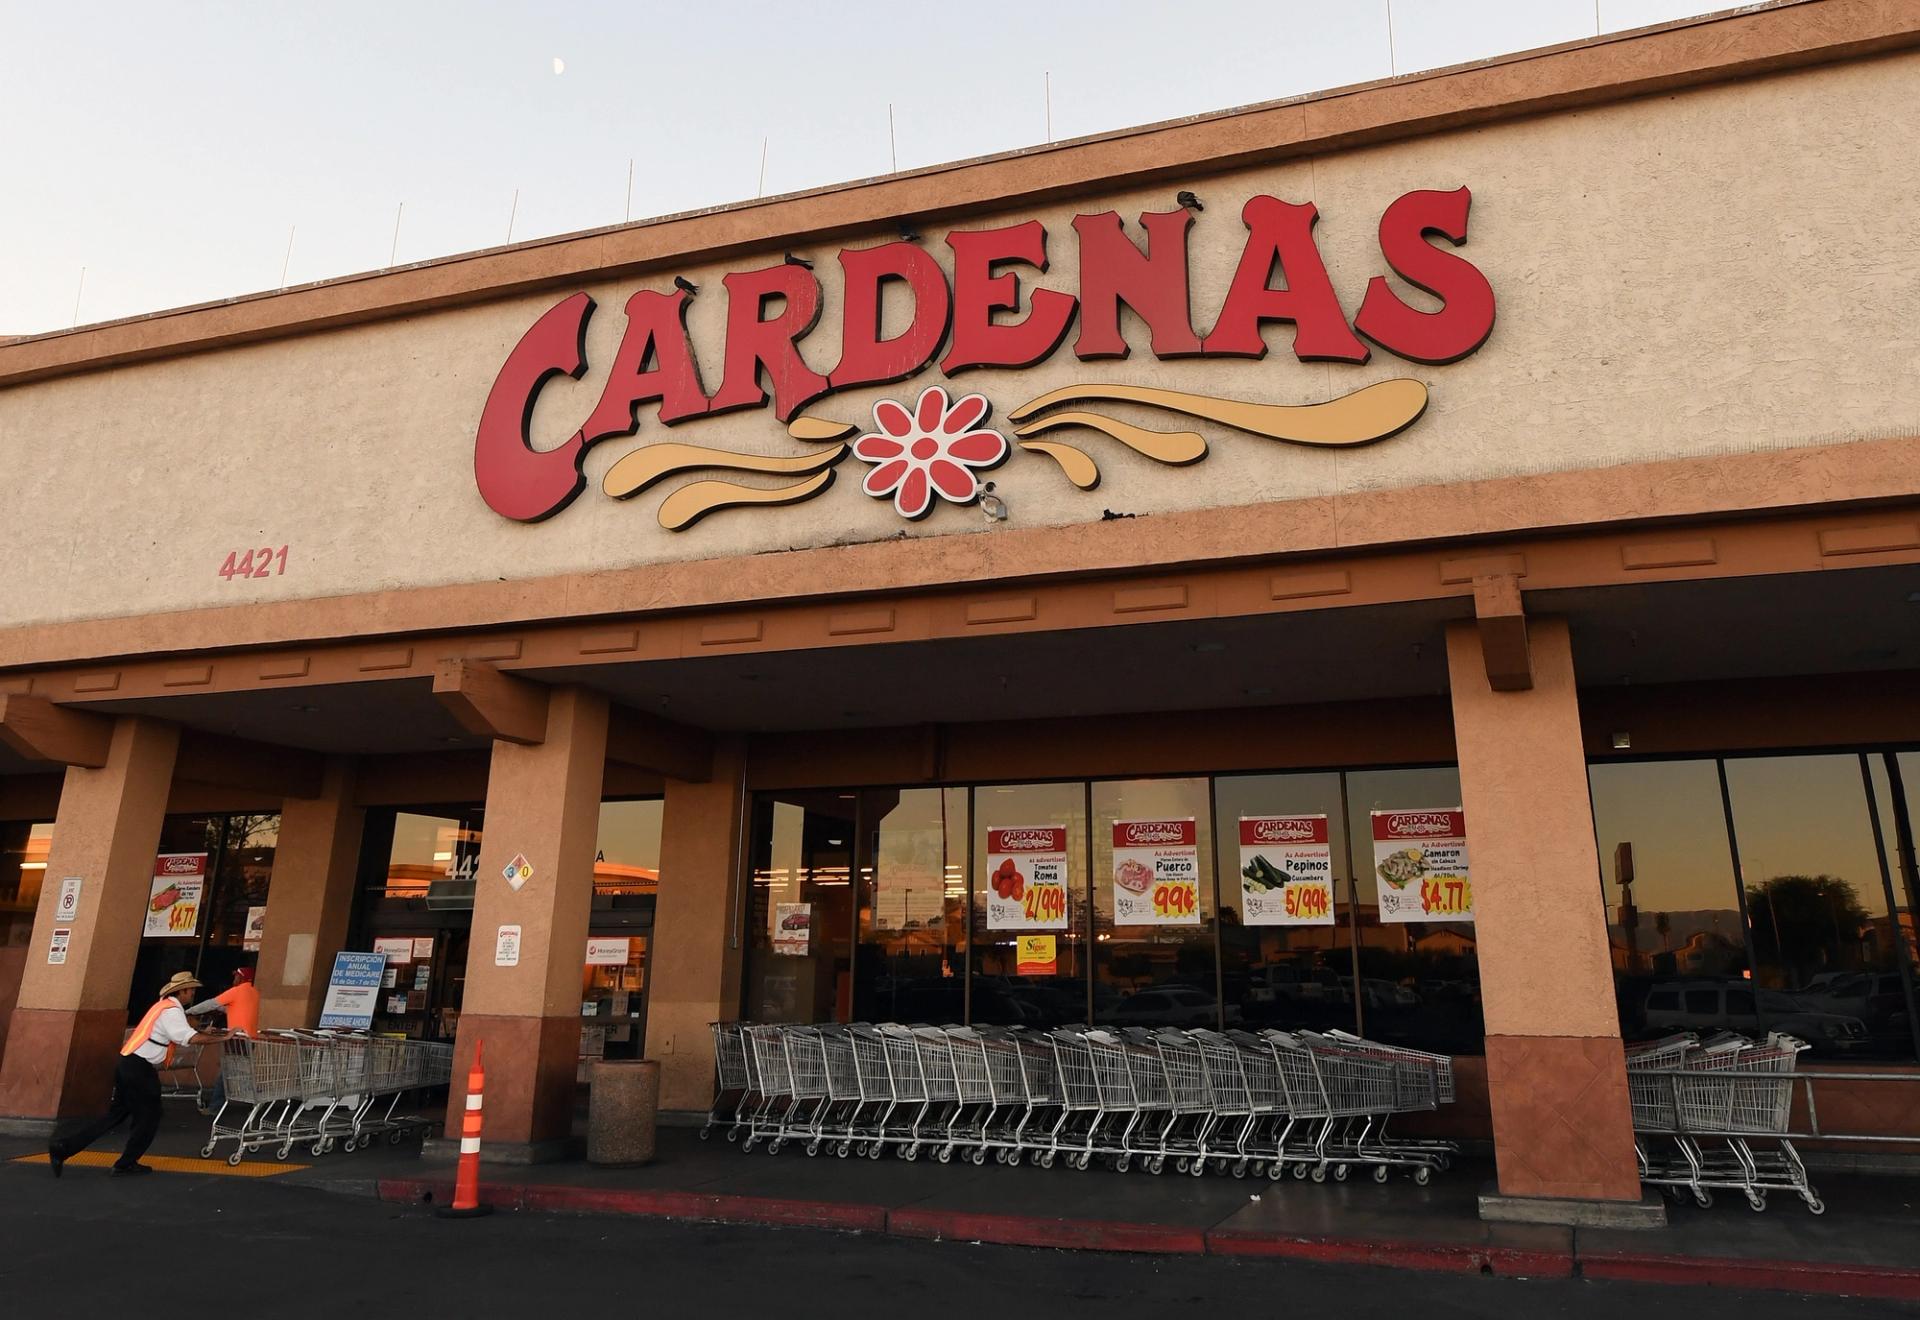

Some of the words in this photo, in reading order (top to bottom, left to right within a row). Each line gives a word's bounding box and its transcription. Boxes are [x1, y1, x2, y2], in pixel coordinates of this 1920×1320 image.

[474, 184, 1497, 523] CARDENAS
[219, 544, 288, 581] 4421
[1127, 823, 1183, 841] CARDENAS
[1254, 820, 1314, 839] CARDENAS
[1388, 814, 1451, 833] CARDENAS
[1001, 830, 1054, 848] CARDENAS
[1424, 849, 1461, 858] Camaron
[522, 866, 529, 877] 0
[1034, 871, 1058, 880] Roma
[1156, 861, 1192, 872] Puerco
[1286, 860, 1328, 874] Pepinos
[1025, 887, 1065, 921] 2/99¢
[1154, 885, 1194, 914] 99¢
[1286, 887, 1328, 917] 5/99¢
[1421, 879, 1464, 915] $4.77
[169, 904, 196, 931] $4.77
[352, 1017, 369, 1026] AHORA
